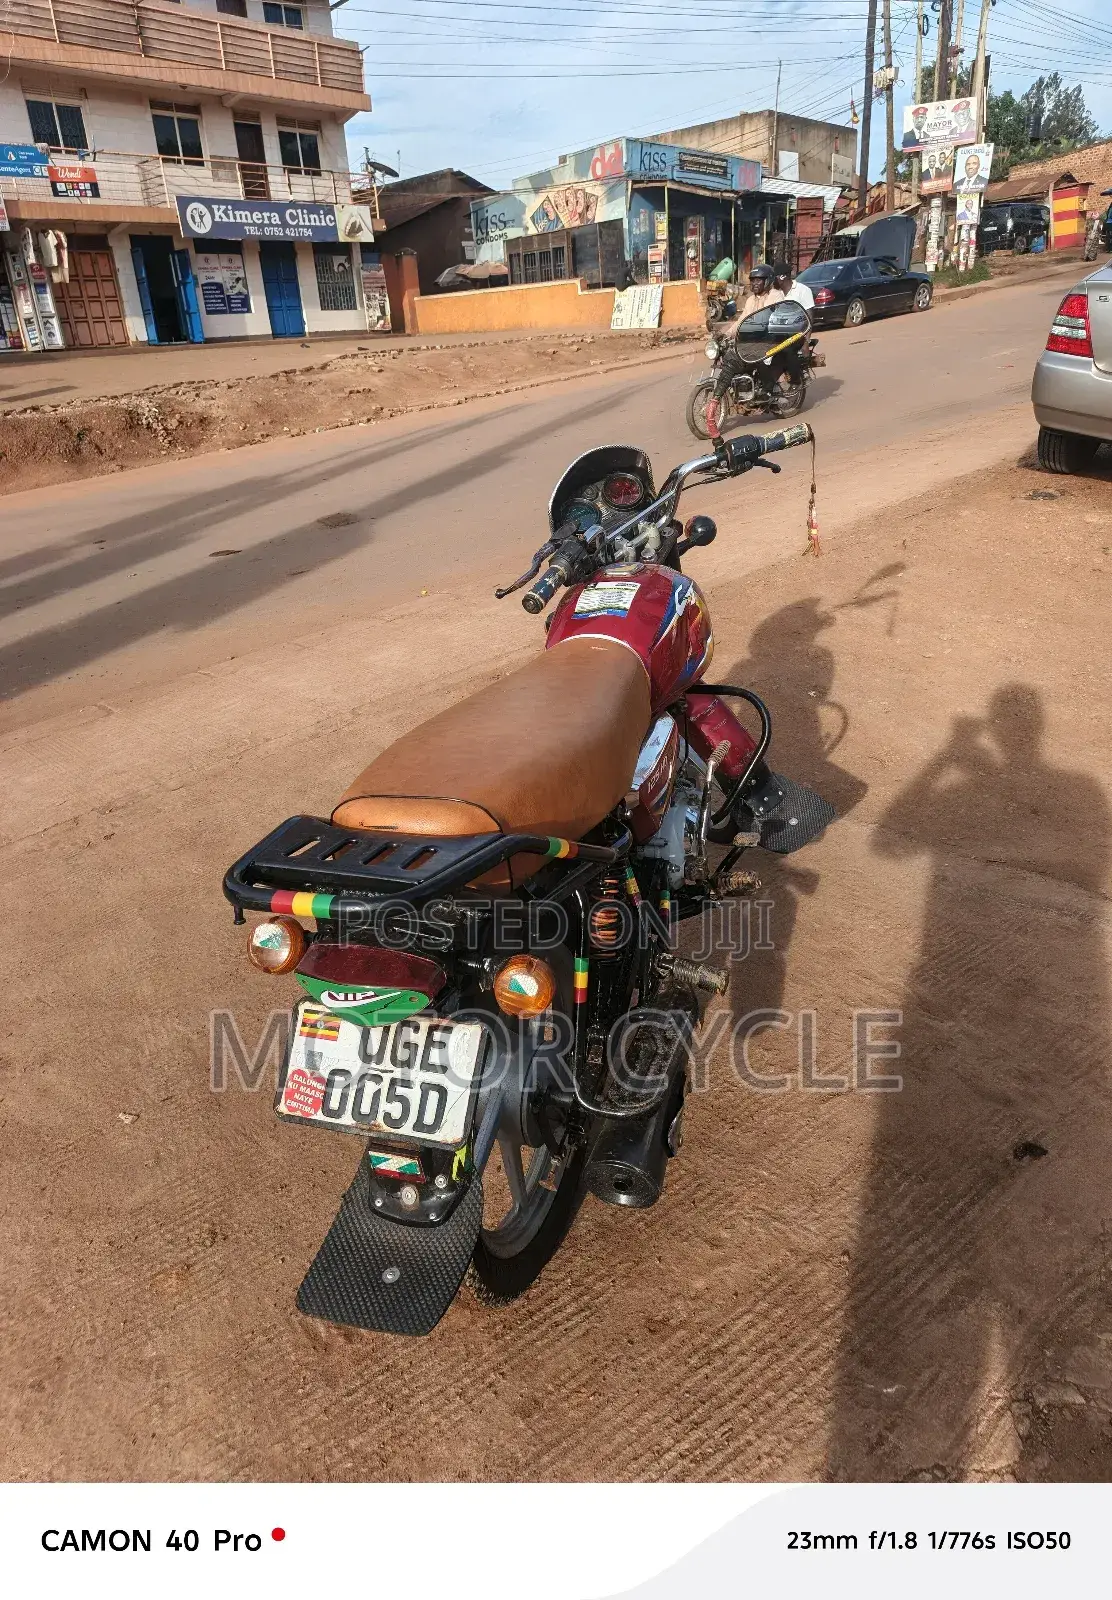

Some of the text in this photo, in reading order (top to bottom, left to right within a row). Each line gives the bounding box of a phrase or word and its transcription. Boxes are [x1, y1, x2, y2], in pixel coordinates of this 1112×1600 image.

[927, 120, 952, 128] MAYOR
[212, 205, 336, 227] Kimera Clinic
[475, 209, 507, 237] kiss
[244, 226, 313, 237] TEL: 0752 421754
[476, 233, 508, 245] CONDOMS
[294, 1093, 313, 1105] NAYE
